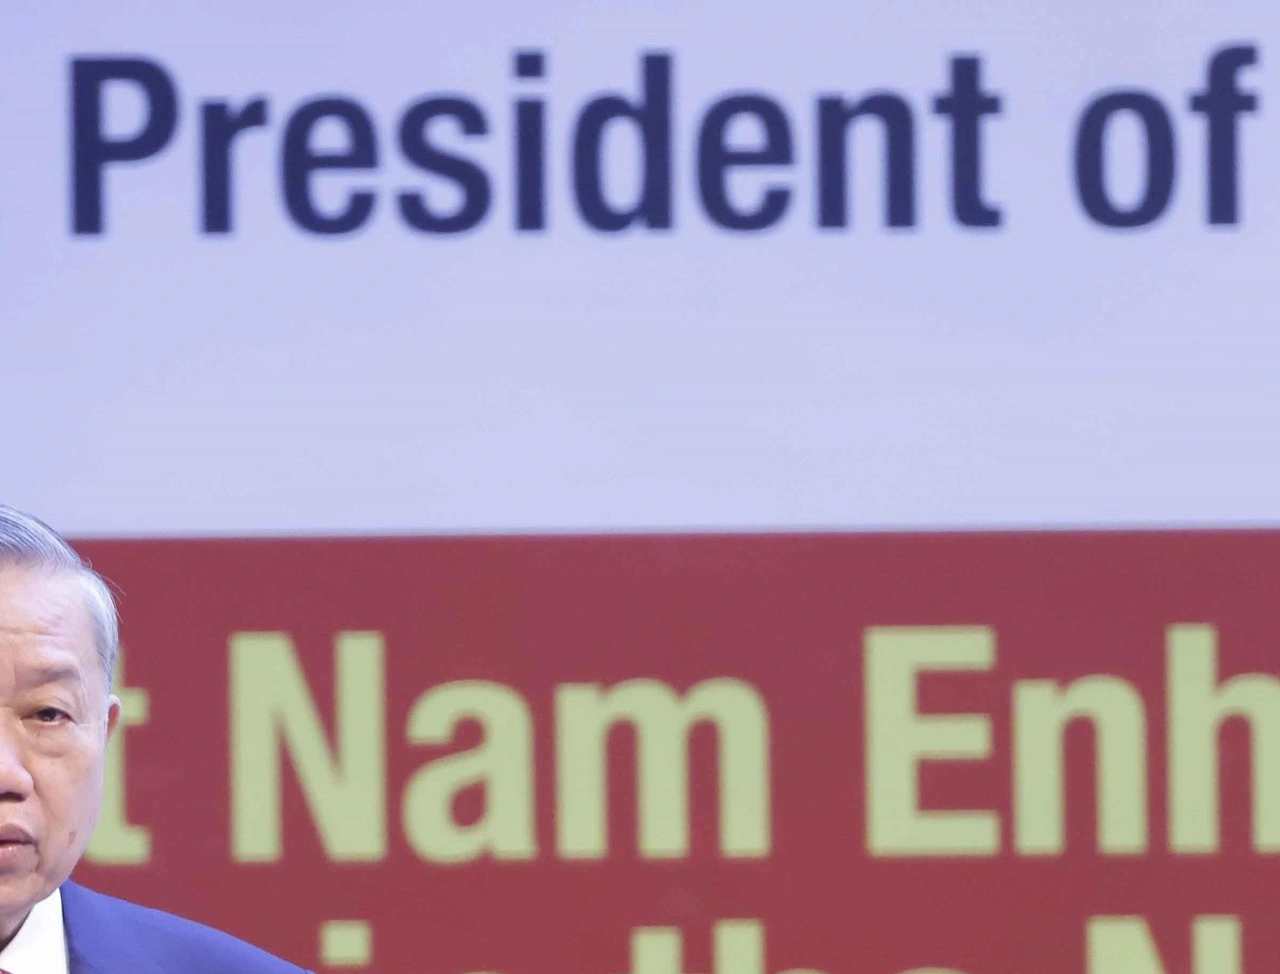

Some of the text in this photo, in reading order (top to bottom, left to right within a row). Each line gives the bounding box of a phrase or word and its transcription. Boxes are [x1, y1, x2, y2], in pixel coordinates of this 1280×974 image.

[68, 50, 1004, 237] President
[1072, 43, 1258, 229] of
[228, 632, 771, 862] Nam
